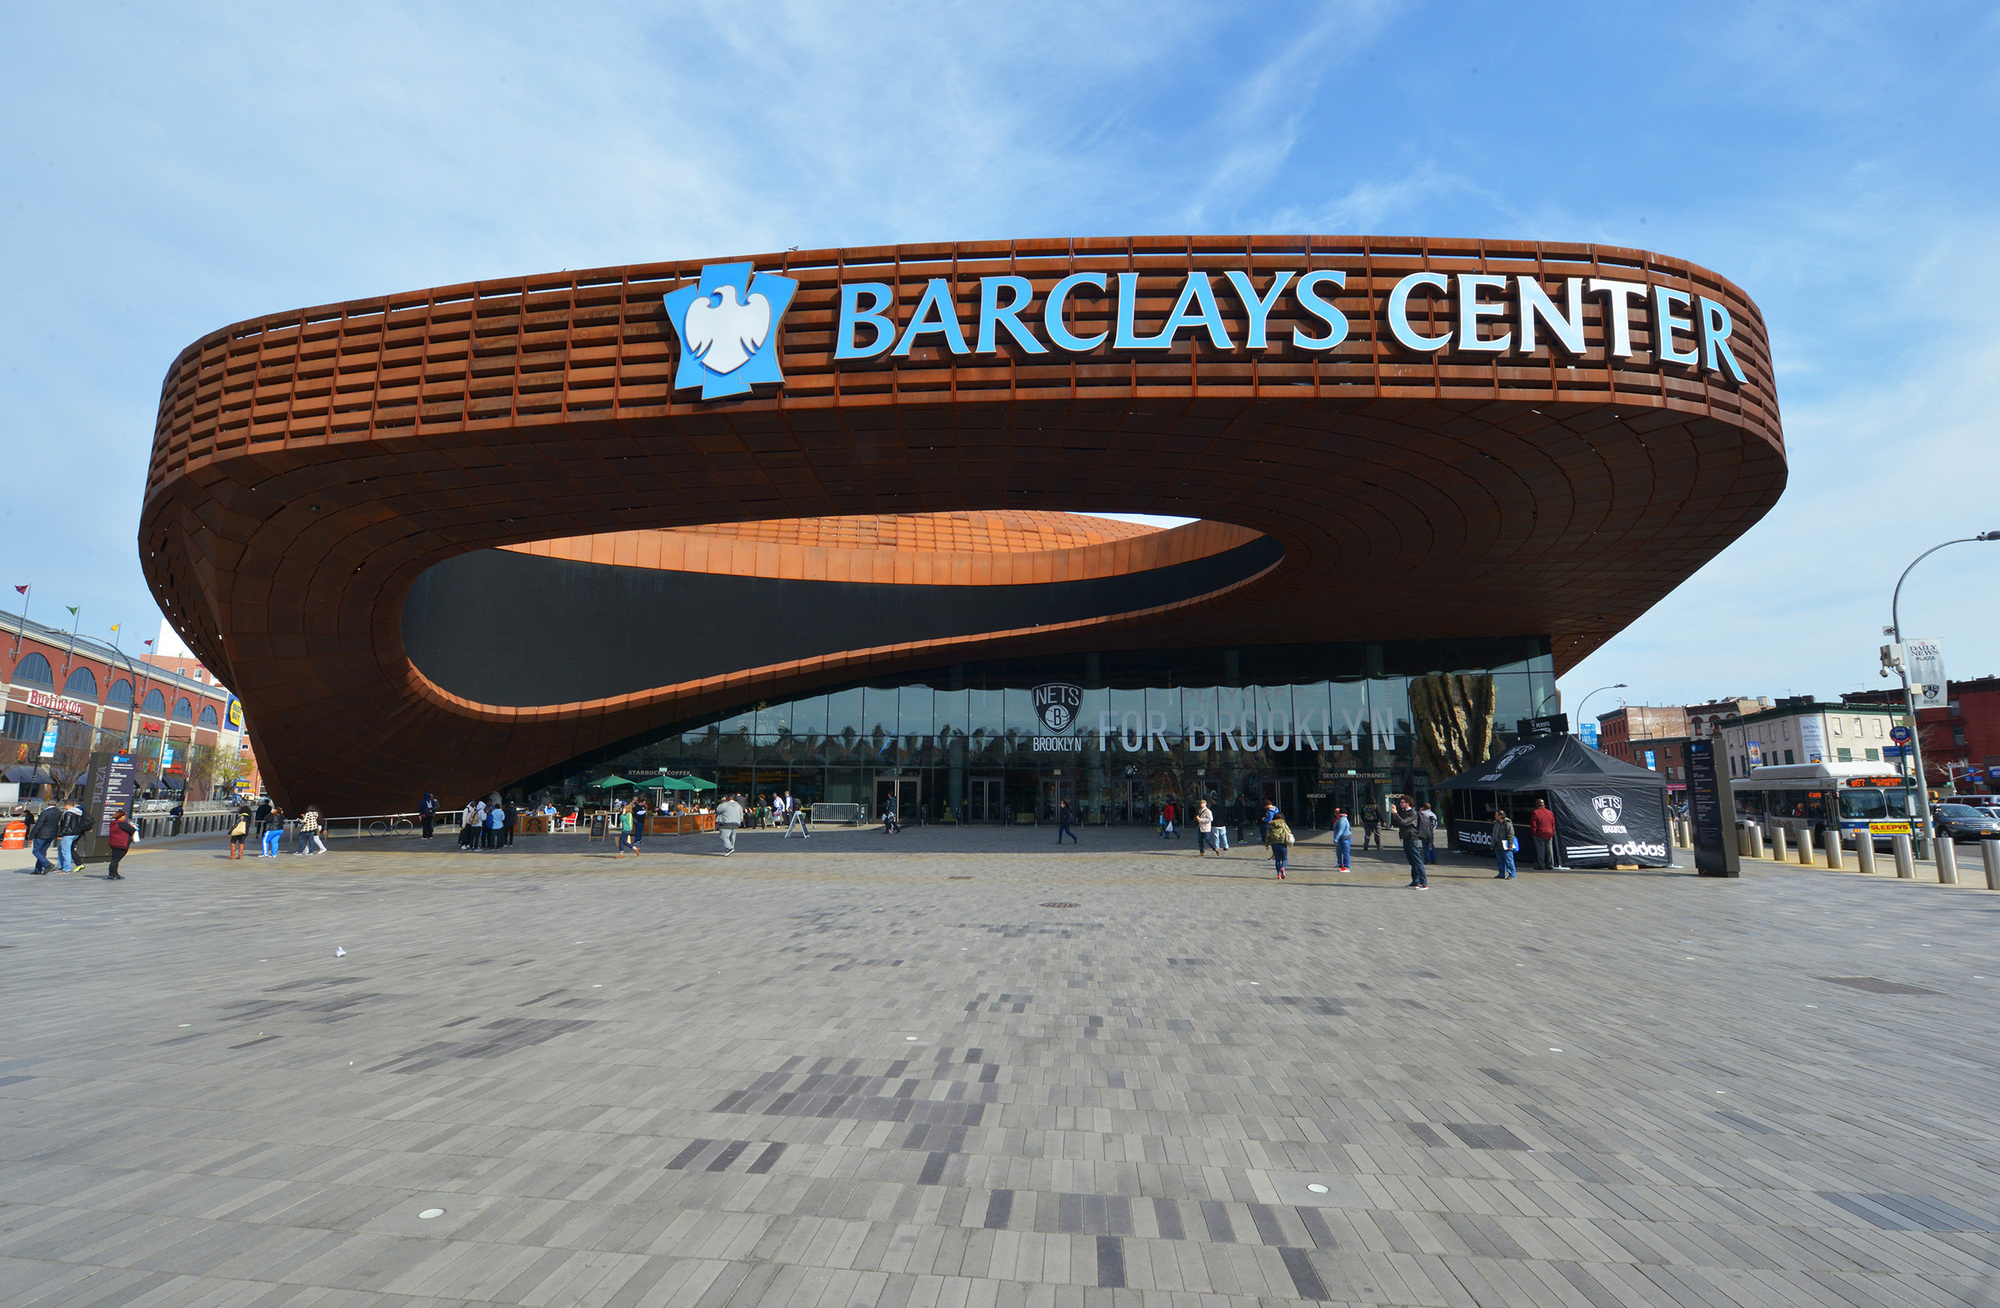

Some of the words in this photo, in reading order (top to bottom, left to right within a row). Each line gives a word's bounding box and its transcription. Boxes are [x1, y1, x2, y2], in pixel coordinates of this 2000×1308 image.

[833, 270, 1349, 360] BARCLAYS
[1387, 272, 1748, 384] CENTER
[1909, 644, 1937, 652] DAILY
[30, 690, 83, 715] Burlington
[1036, 685, 1080, 707] NETS
[1099, 709, 1171, 752] FOR
[1188, 706, 1397, 752] BROOKLYN
[1033, 737, 1082, 752] BROOKLYN
[92, 766, 107, 803] PLAZA
[1593, 796, 1621, 809] NETS
[1602, 825, 1628, 834] BROOKLYN
[1611, 841, 1666, 857] adidas
